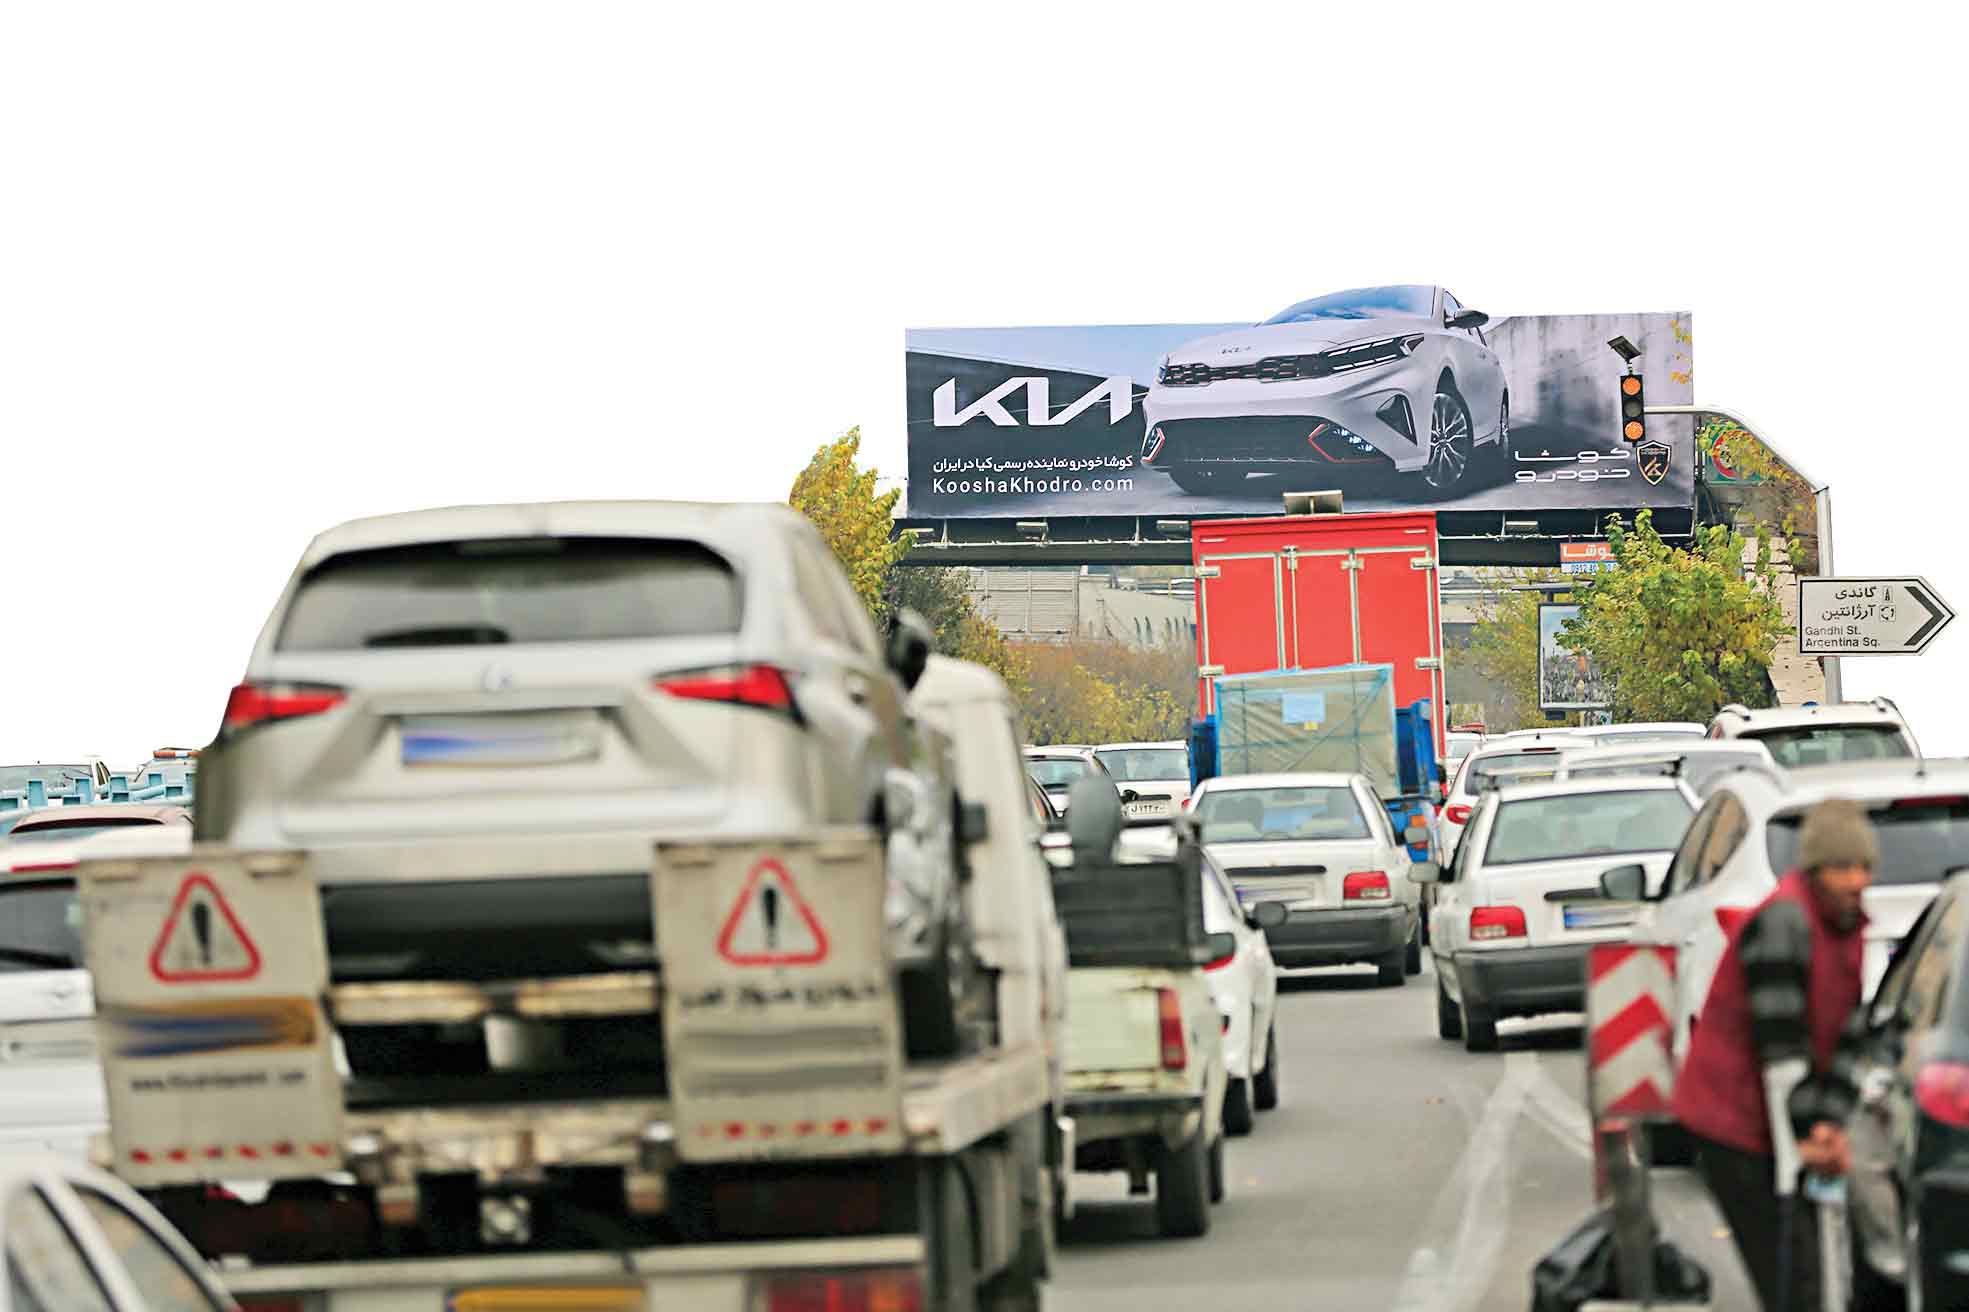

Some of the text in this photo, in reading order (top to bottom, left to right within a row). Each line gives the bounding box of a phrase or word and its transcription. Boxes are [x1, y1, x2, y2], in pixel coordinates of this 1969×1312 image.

[933, 376, 1133, 427] KIA
[933, 455, 1133, 473] کوشا خودرو نماینده رسمی کیا در ایران
[933, 475, 1133, 494] KooshaKhodro.com
[1835, 586, 1877, 600] گاندی
[1822, 603, 1877, 621] آرژانتین
[1805, 625, 1861, 636] Gandhi St.
[1862, 637, 1881, 648] Sq.
